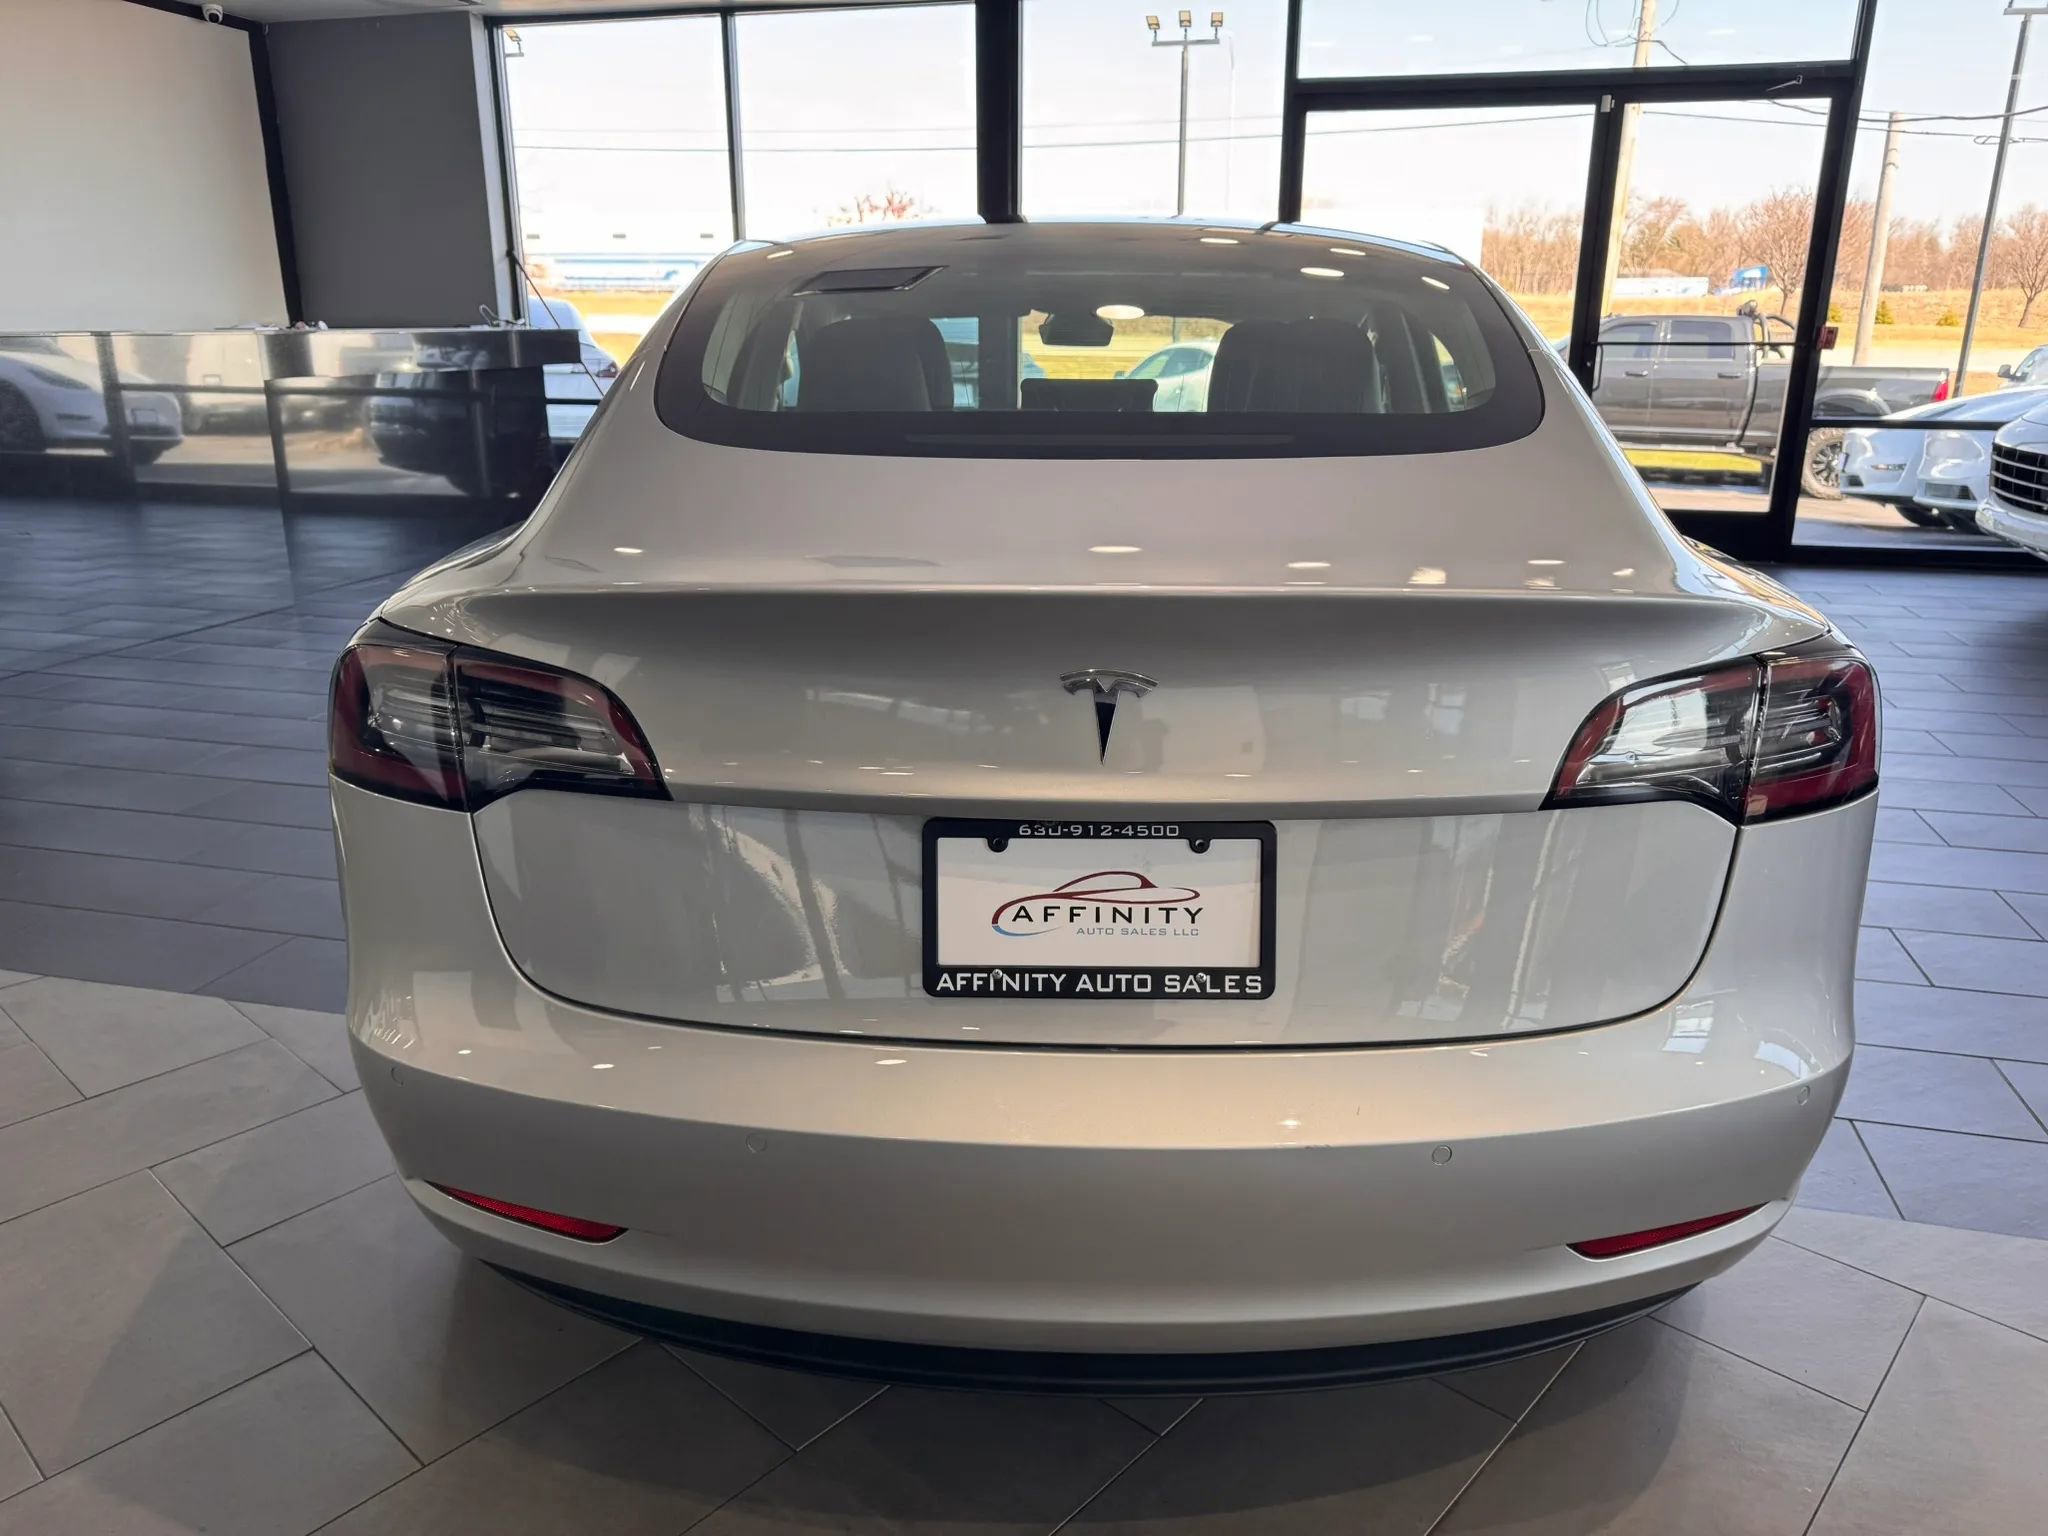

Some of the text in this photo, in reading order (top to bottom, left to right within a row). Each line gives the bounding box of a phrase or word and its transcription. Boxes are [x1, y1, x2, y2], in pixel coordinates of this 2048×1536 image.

[1018, 824, 1180, 837] 630-912-4500
[1011, 905, 1204, 925] AFFINITY
[1076, 927, 1200, 937] AUTO SALES LLC
[936, 972, 1262, 994] AFFINITY AUTO SALES
